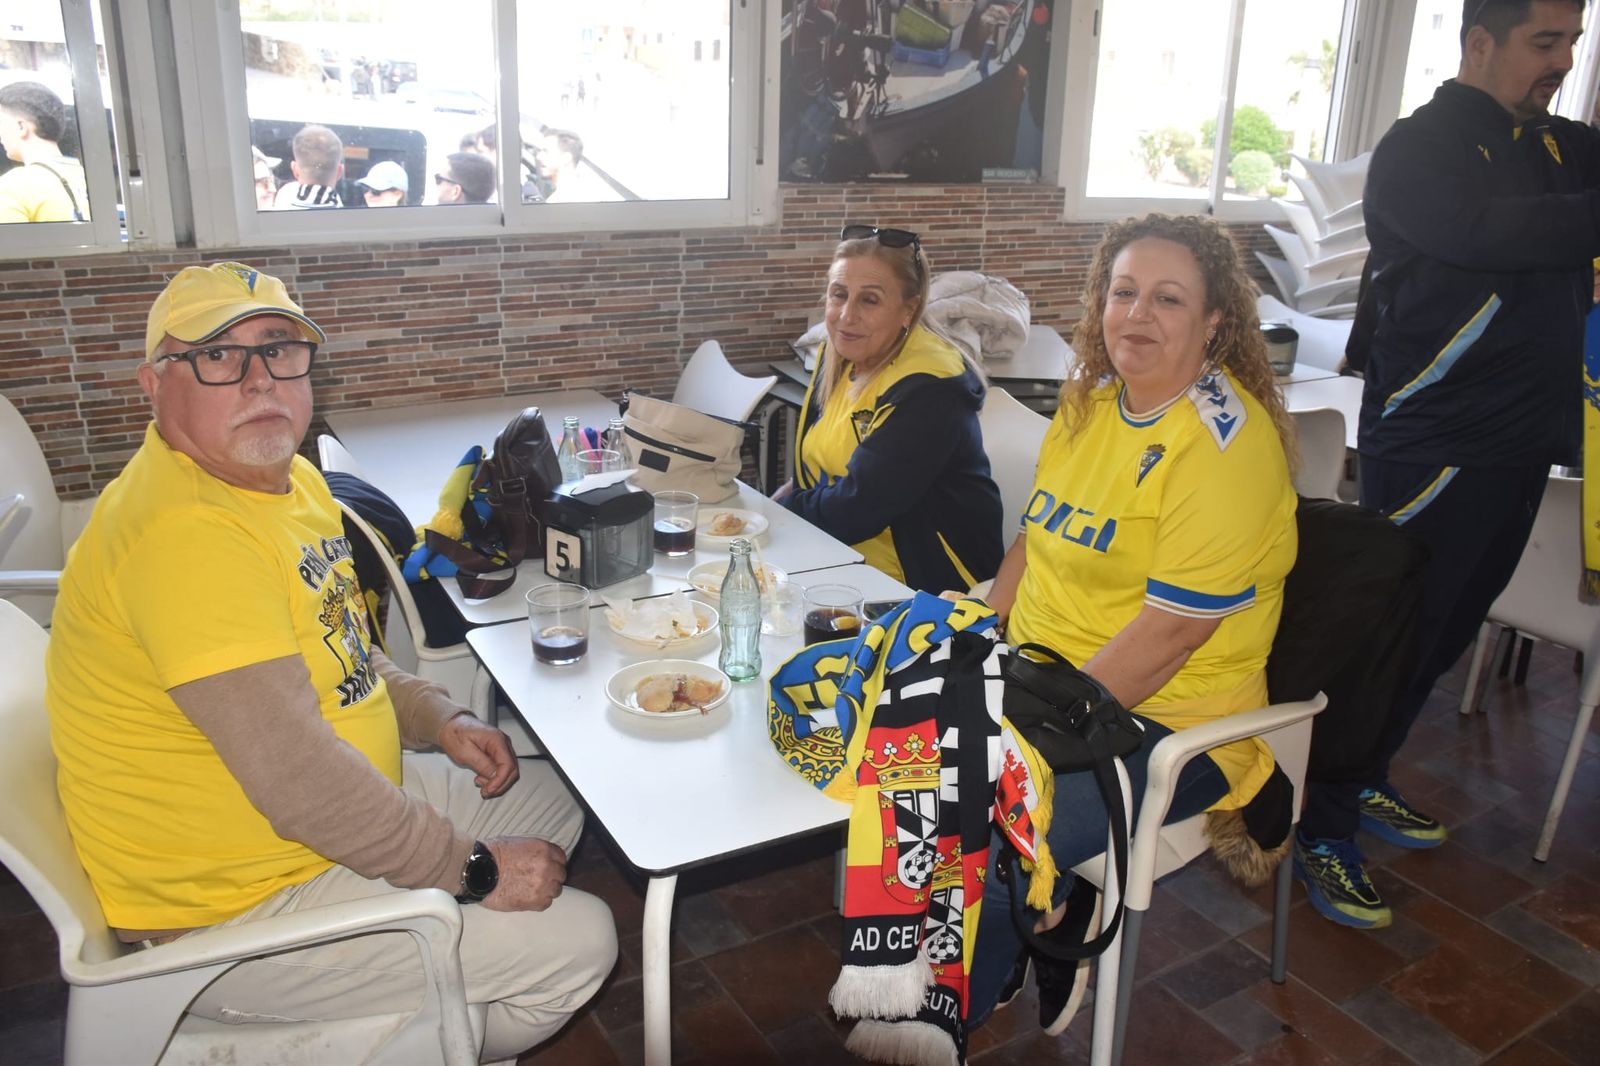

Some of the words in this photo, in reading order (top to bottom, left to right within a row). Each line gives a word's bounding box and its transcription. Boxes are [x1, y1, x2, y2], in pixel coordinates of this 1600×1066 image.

[1026, 489, 1117, 553] DIGI
[556, 540, 571, 572] 5
[850, 927, 880, 951] AD
